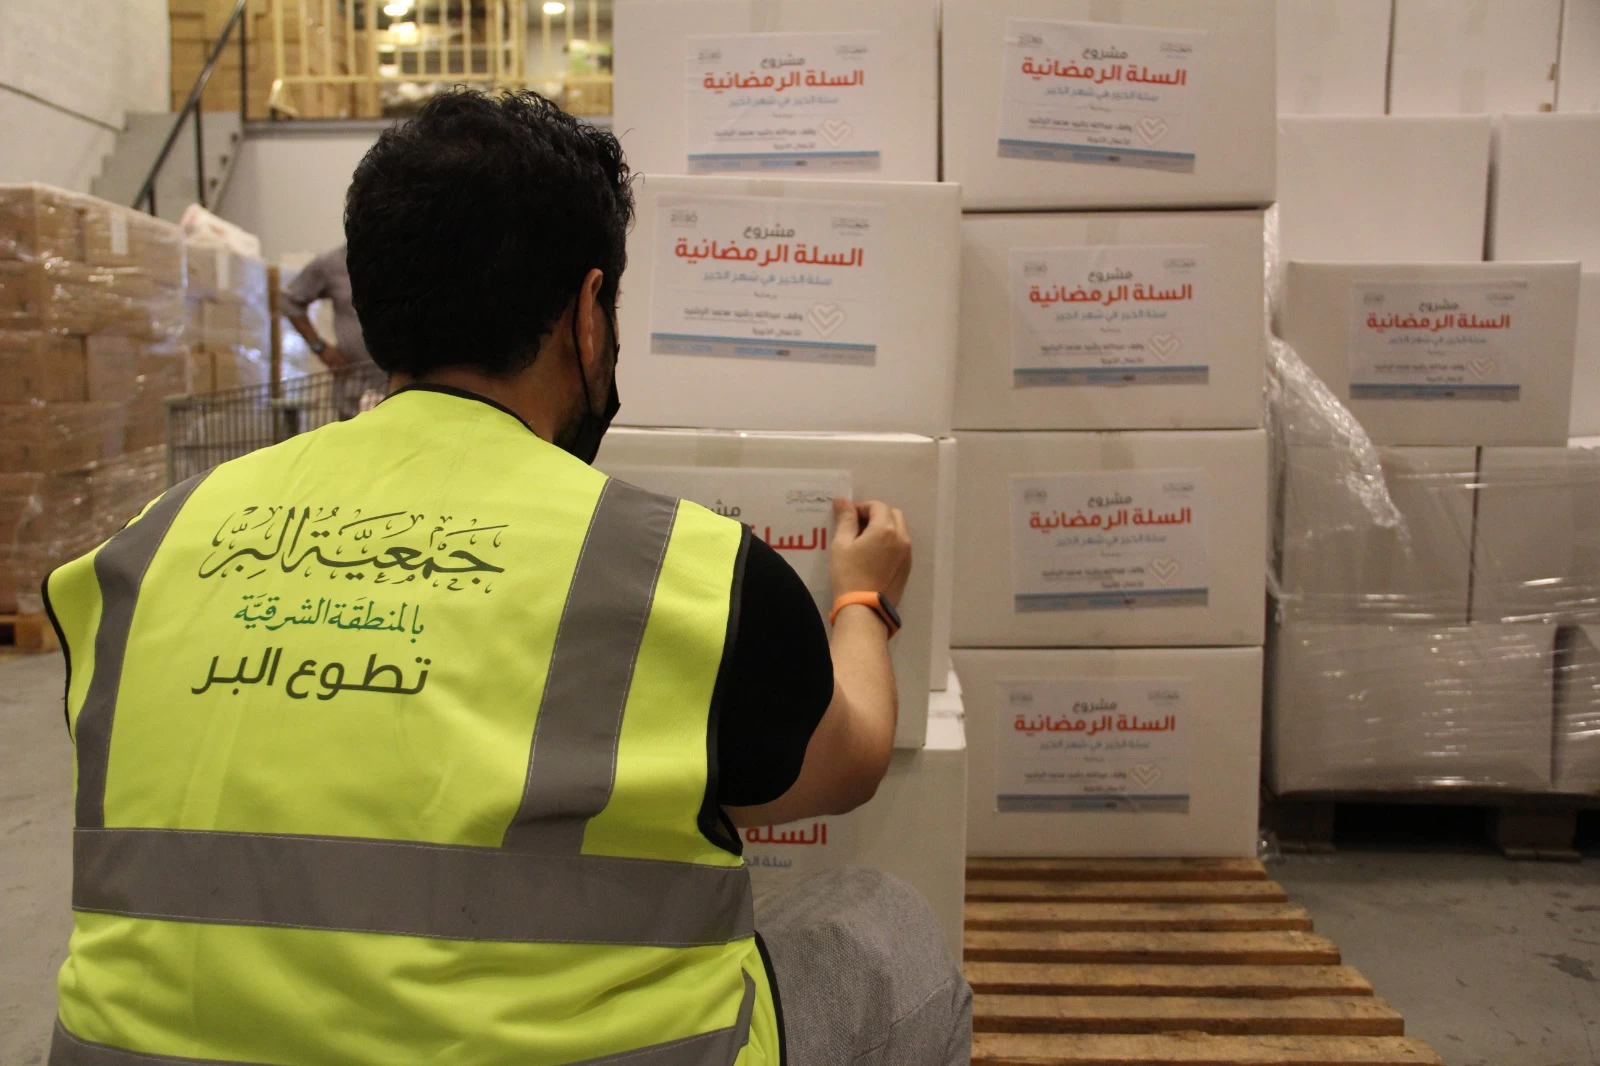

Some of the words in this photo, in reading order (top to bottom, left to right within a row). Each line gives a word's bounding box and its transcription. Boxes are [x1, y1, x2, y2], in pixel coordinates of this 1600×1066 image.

[760, 53, 805, 69] مشروع
[1082, 45, 1128, 60] مشروع
[805, 69, 865, 87] السلة
[1021, 57, 1121, 84] الرمضانية
[1126, 64, 1187, 87] السلة
[703, 70, 801, 94] الرمضانية
[743, 222, 795, 239] مشروع
[675, 237, 789, 267] الرمضانية
[793, 243, 864, 267] السلة
[702, 269, 730, 281] الخير
[777, 273, 806, 286] الخير
[1087, 267, 1133, 283] مشروع
[1028, 284, 1128, 308] الرمضانية
[1132, 284, 1193, 301] السلة
[1419, 297, 1459, 312] مشروع
[1367, 312, 1453, 334] الرمضانية
[1457, 313, 1510, 329] السلة
[1087, 491, 1133, 508] مشروع
[1029, 509, 1127, 534] الرمضانية
[1132, 506, 1191, 525] السلة
[751, 524, 827, 550] السل
[233, 594, 331, 631] الشرقية
[327, 595, 425, 645] بالمنطقة
[190, 646, 283, 696] البر
[285, 653, 432, 701] تطوع
[1072, 697, 1118, 713] مشروع
[1014, 714, 1112, 737] الرمضانية
[1116, 714, 1176, 732] السلة
